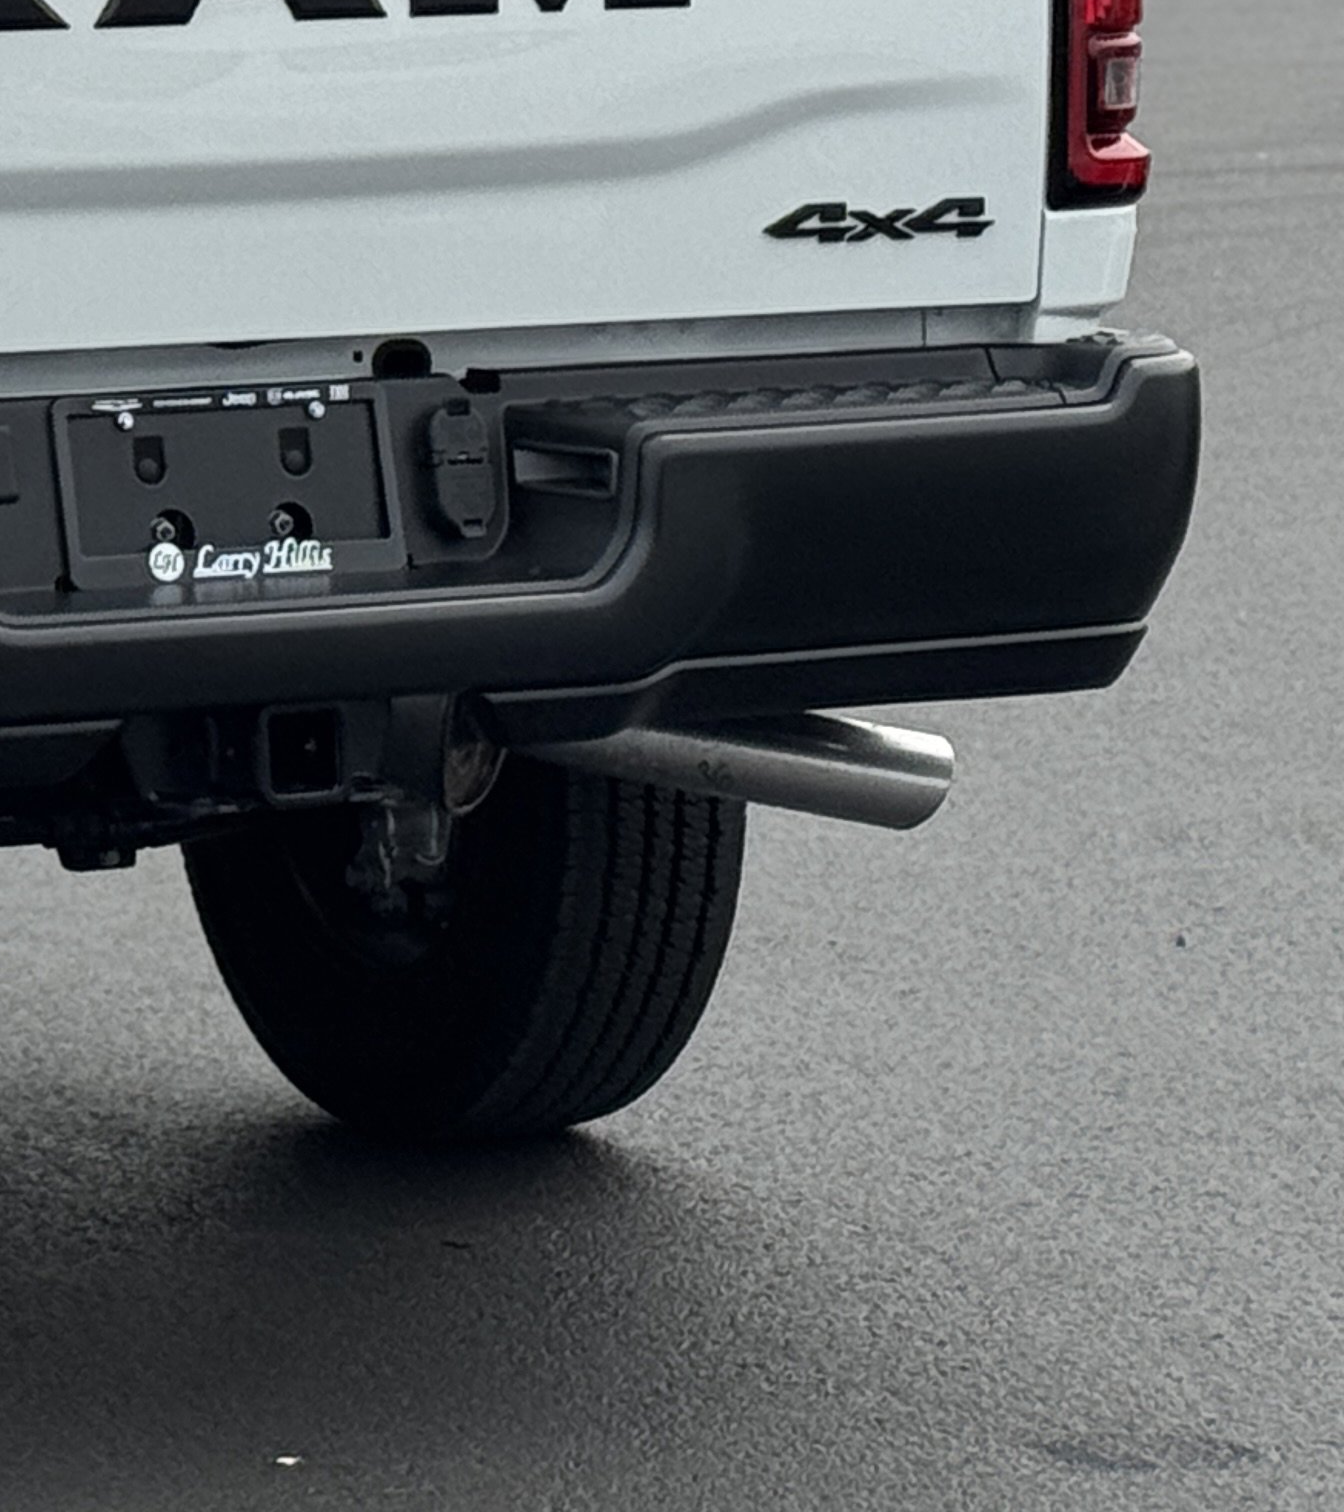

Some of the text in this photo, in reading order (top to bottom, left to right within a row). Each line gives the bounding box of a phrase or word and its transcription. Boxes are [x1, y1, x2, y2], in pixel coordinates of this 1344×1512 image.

[762, 196, 994, 244] 4x4
[193, 545, 260, 579] Larry
[263, 538, 333, 574] Hillis
